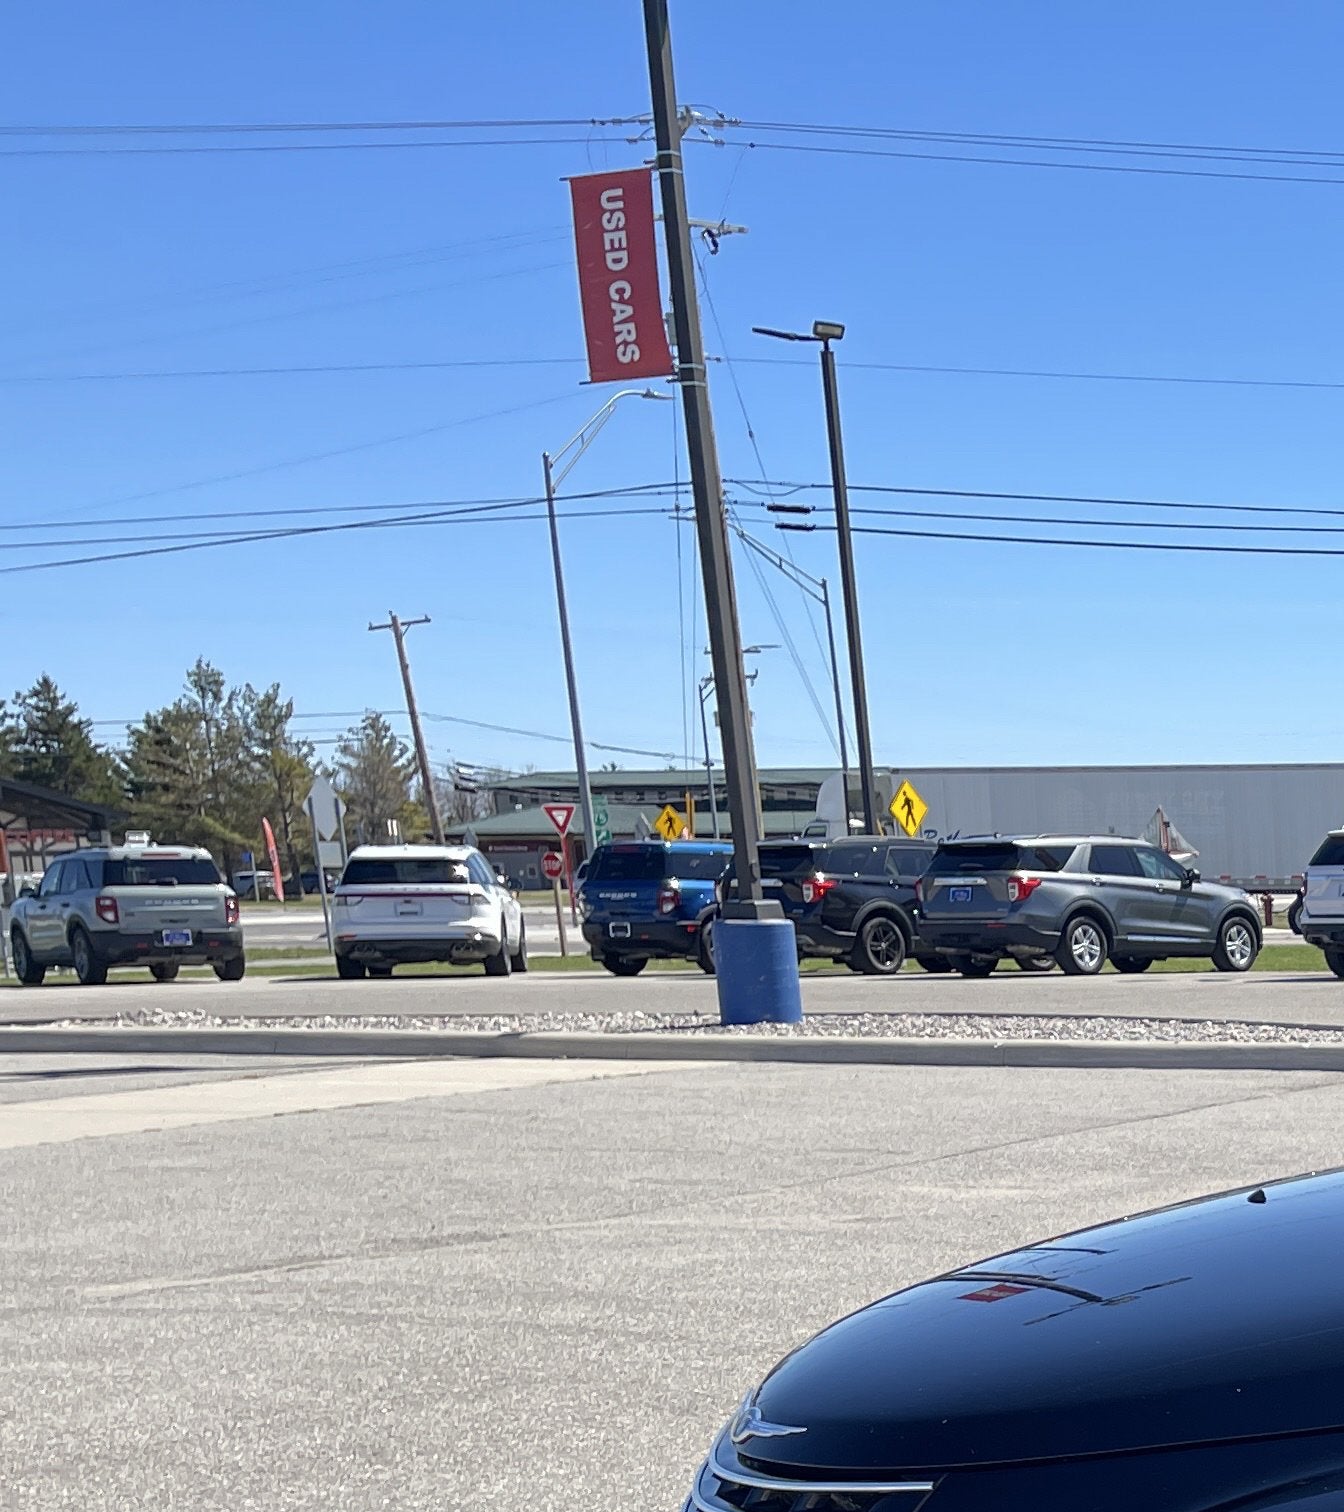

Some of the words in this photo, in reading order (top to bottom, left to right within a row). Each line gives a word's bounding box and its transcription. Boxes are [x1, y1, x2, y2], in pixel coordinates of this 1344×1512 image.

[600, 187, 630, 272] USED
[608, 279, 641, 365] CARS
[543, 859, 561, 870] STOP
